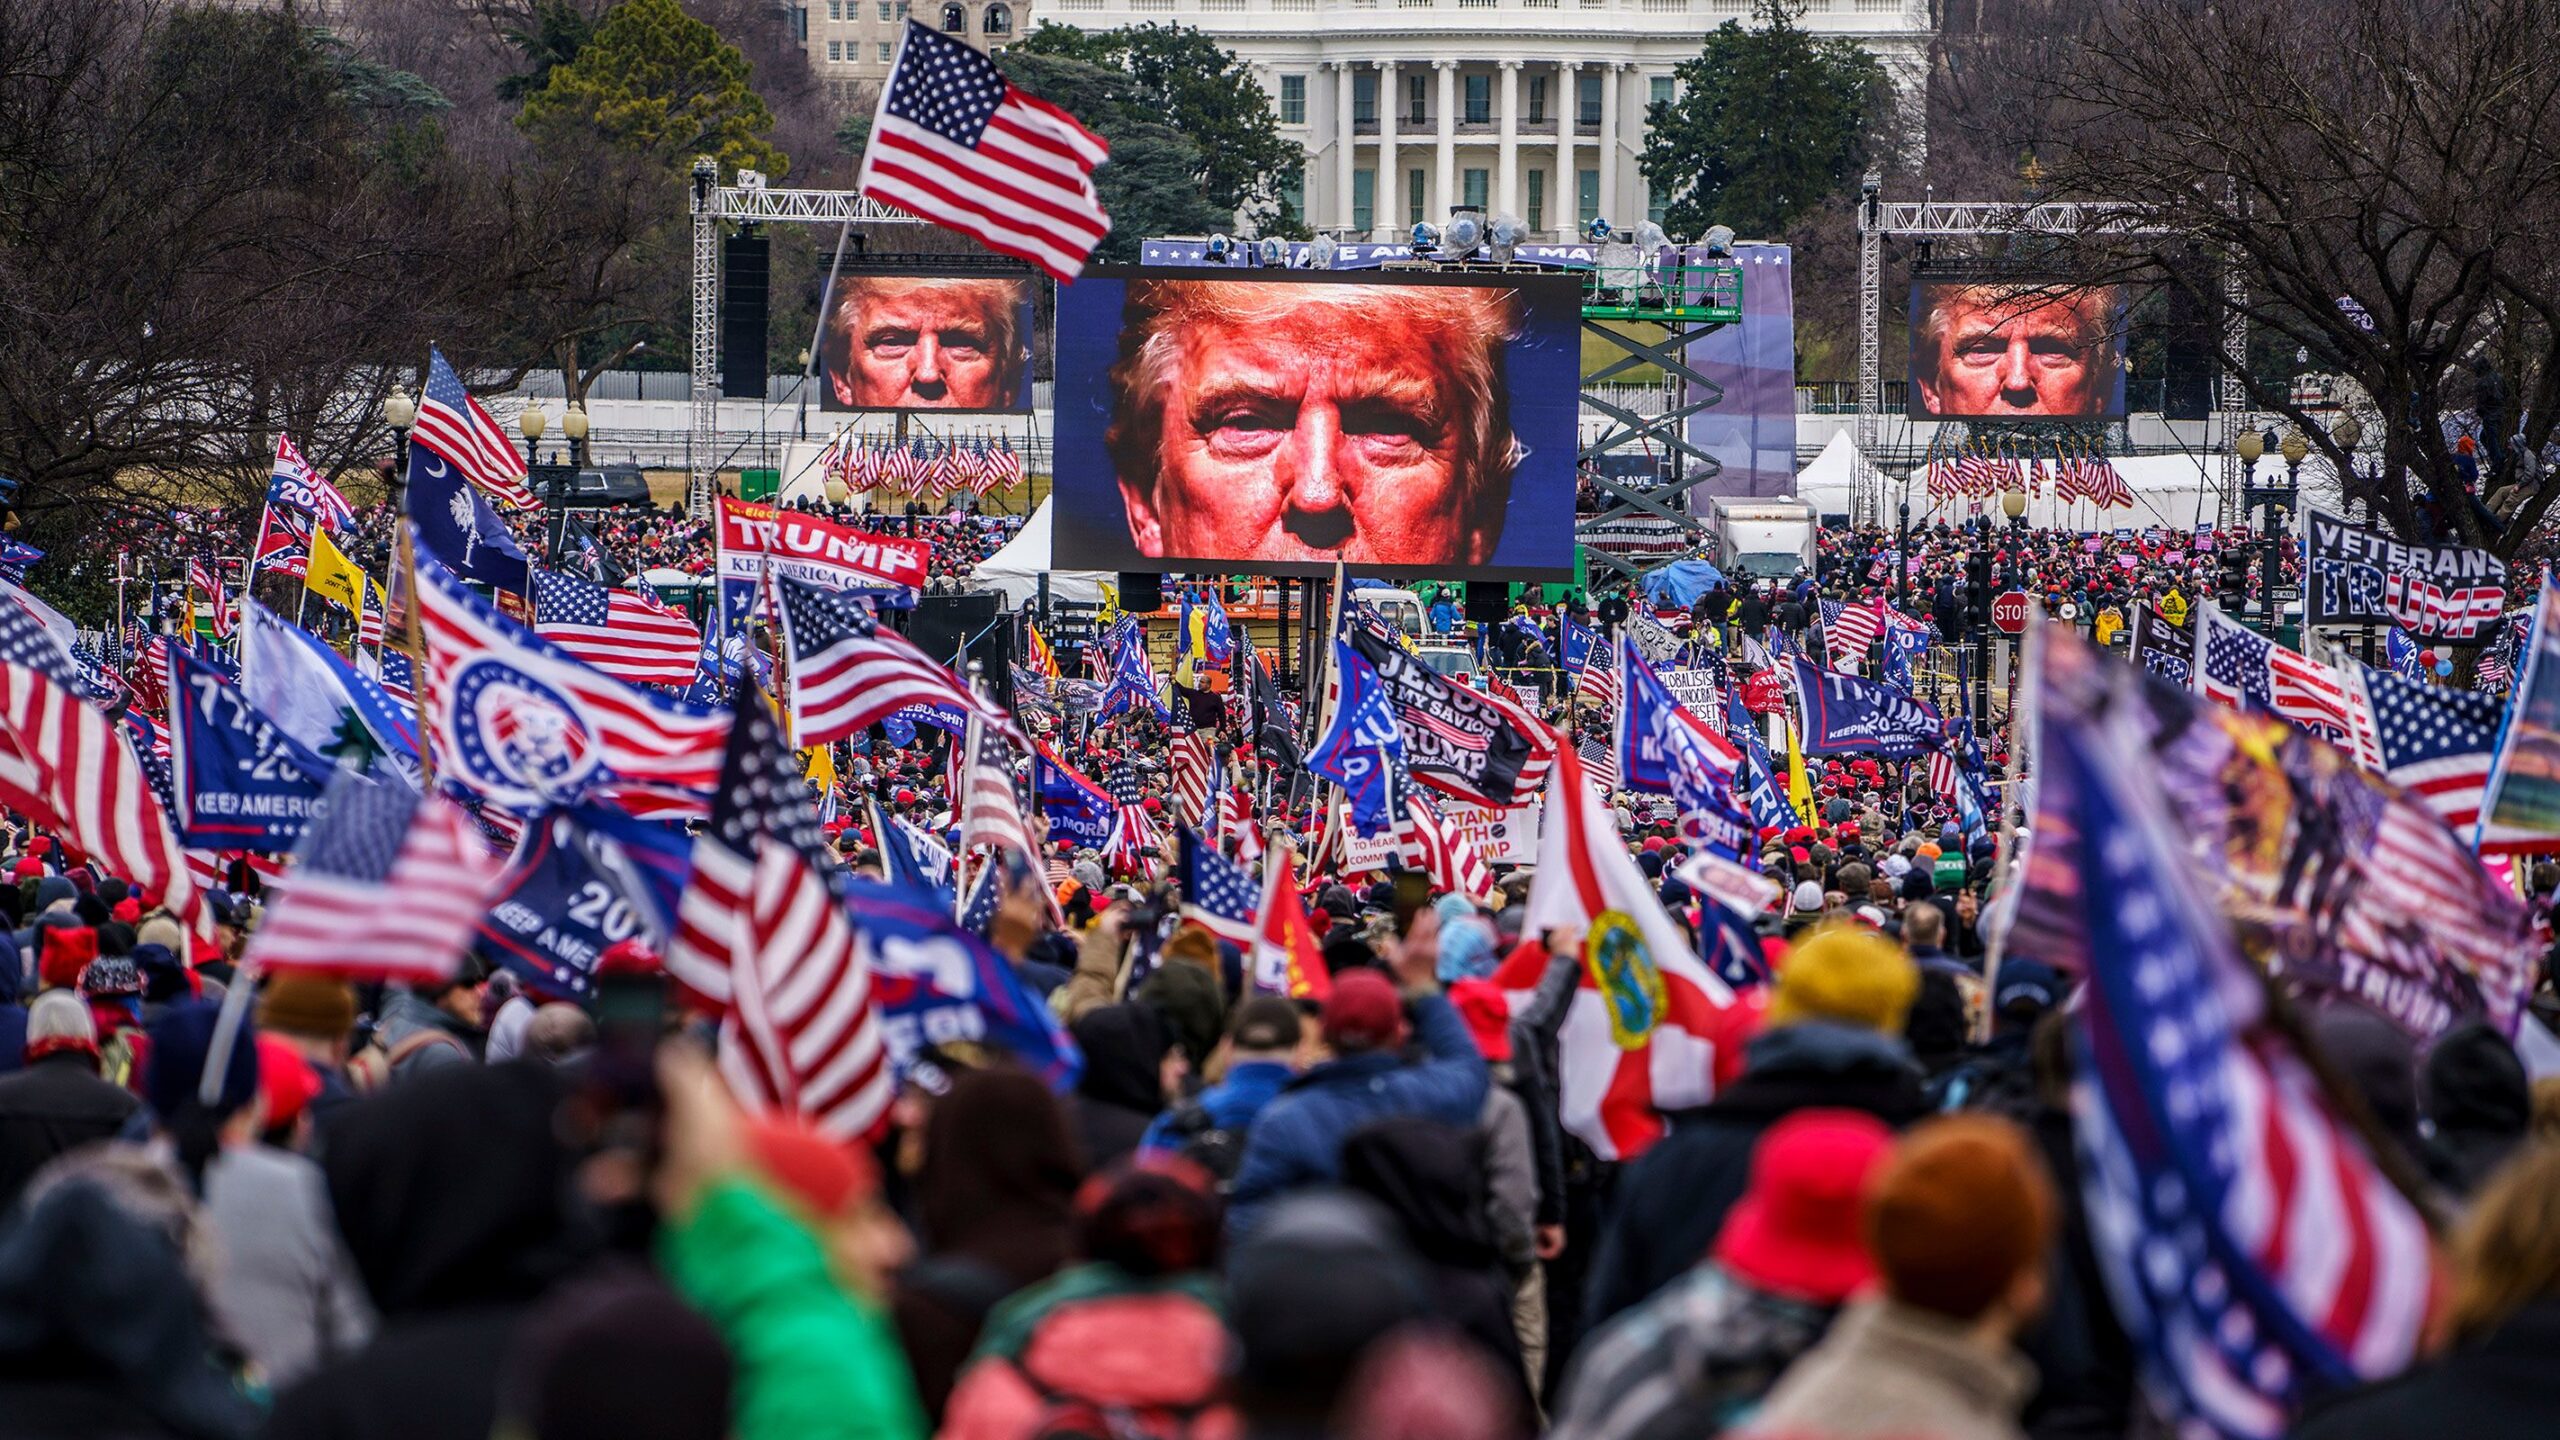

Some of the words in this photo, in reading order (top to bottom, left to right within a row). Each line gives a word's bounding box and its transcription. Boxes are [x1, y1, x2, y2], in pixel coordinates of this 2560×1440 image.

[1617, 475, 1651, 485] SAVE
[730, 515, 917, 574] TRUMP
[2316, 521, 2506, 577] VETERANS
[262, 555, 289, 569] Come
[777, 563, 839, 585] AMERICA
[2313, 557, 2506, 638] TRUMP
[1996, 605, 2030, 620] STOP
[1567, 657, 1584, 665] KEEP
[1383, 681, 1394, 696] S
[1397, 686, 1424, 708] MY
[1429, 701, 1496, 741] SAVIOR
[1397, 719, 1487, 779] RUMP
[196, 792, 237, 815] KEEP
[240, 792, 329, 820] AMERIC
[1050, 816, 1060, 830] O
[1355, 841, 1366, 851] TO
[1370, 838, 1395, 849] HEAR
[1462, 828, 1488, 842] TH
[1350, 856, 1386, 866] COMM
[1470, 842, 1510, 861] UMP
[567, 880, 638, 942] -20
[536, 925, 604, 975] AME
[2340, 951, 2452, 1034] TRUMP
